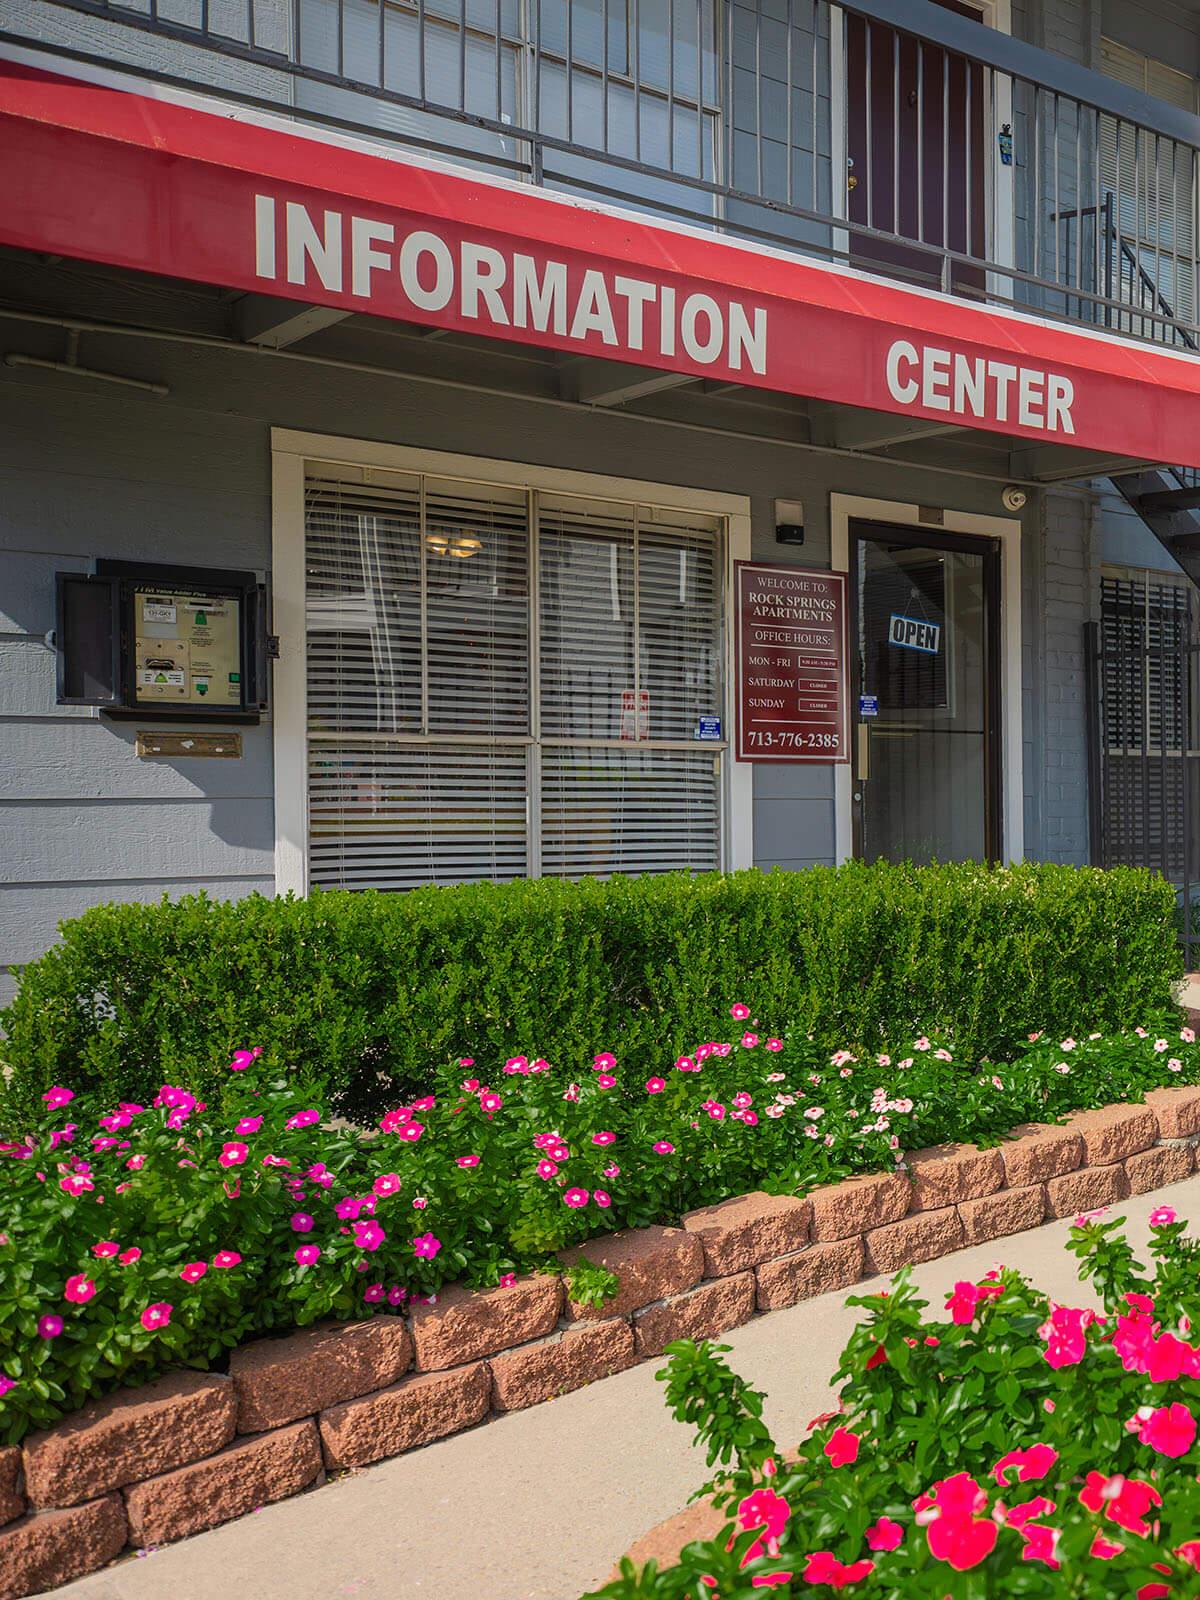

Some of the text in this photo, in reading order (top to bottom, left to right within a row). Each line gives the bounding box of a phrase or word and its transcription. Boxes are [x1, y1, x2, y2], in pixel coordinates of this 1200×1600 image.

[255, 194, 1075, 434] INFORMATION CENTER
[757, 577, 828, 593] WELCOME TO:
[749, 592, 836, 610] ROCK SPRINGS
[753, 606, 833, 622] APARTMENTS
[755, 631, 831, 645] OFFICE HOURS:
[893, 618, 937, 650] OPEN
[749, 656, 770, 666] MON
[777, 658, 791, 667] FRI
[748, 677, 795, 688] SATURDAY
[749, 698, 785, 708] SUNDAY
[748, 731, 840, 748] 713-776-2385
